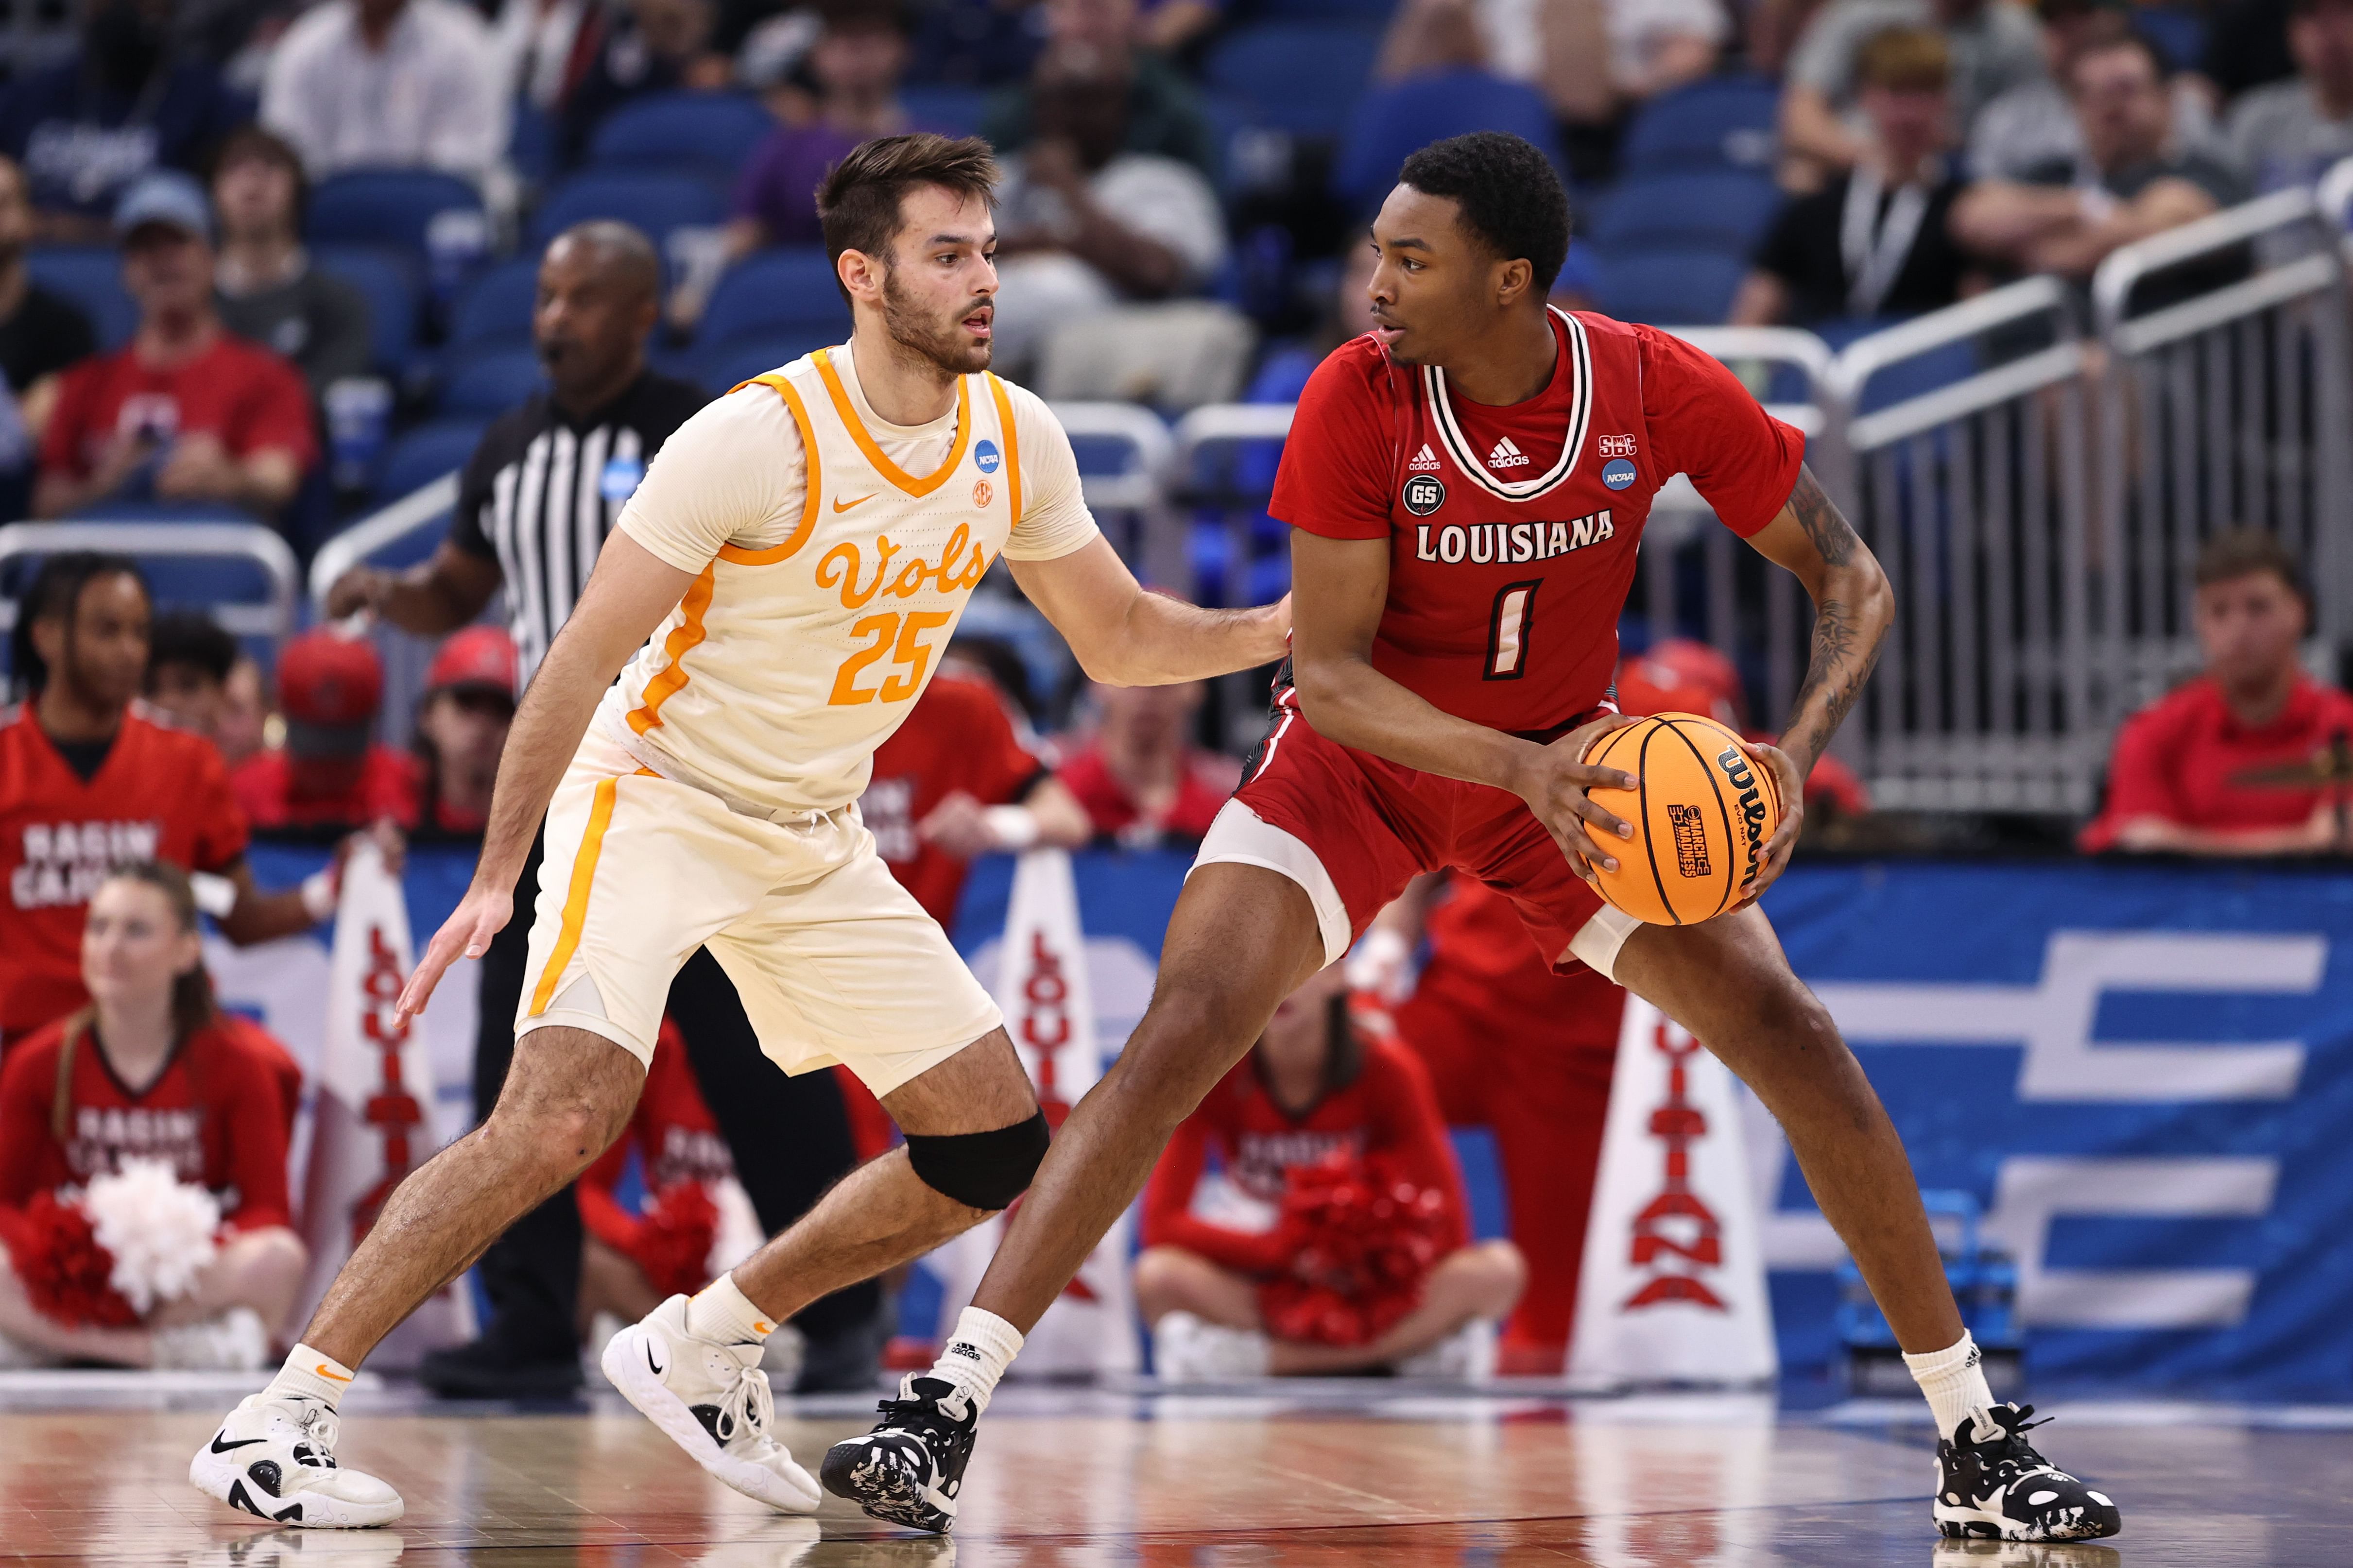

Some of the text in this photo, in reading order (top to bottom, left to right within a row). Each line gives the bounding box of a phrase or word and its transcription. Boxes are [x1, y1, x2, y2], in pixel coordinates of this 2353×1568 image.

[1598, 434, 1637, 457] SBC
[979, 454, 999, 465] NCAA
[1409, 461, 1441, 471] adidas
[1488, 455, 1529, 469] adidas
[1607, 472, 1634, 483] NCAA
[975, 482, 991, 506] SEC
[1411, 485, 1437, 504] GS
[1416, 508, 1614, 564] LOUISIANA
[815, 522, 1000, 609] Vols
[1483, 578, 1545, 681] 1
[827, 610, 953, 705] 25
[1717, 745, 1766, 892] Wilson
[1734, 804, 1743, 824] EVO
[1688, 819, 1703, 858] MARCH
[1678, 826, 1697, 877] MADNESS
